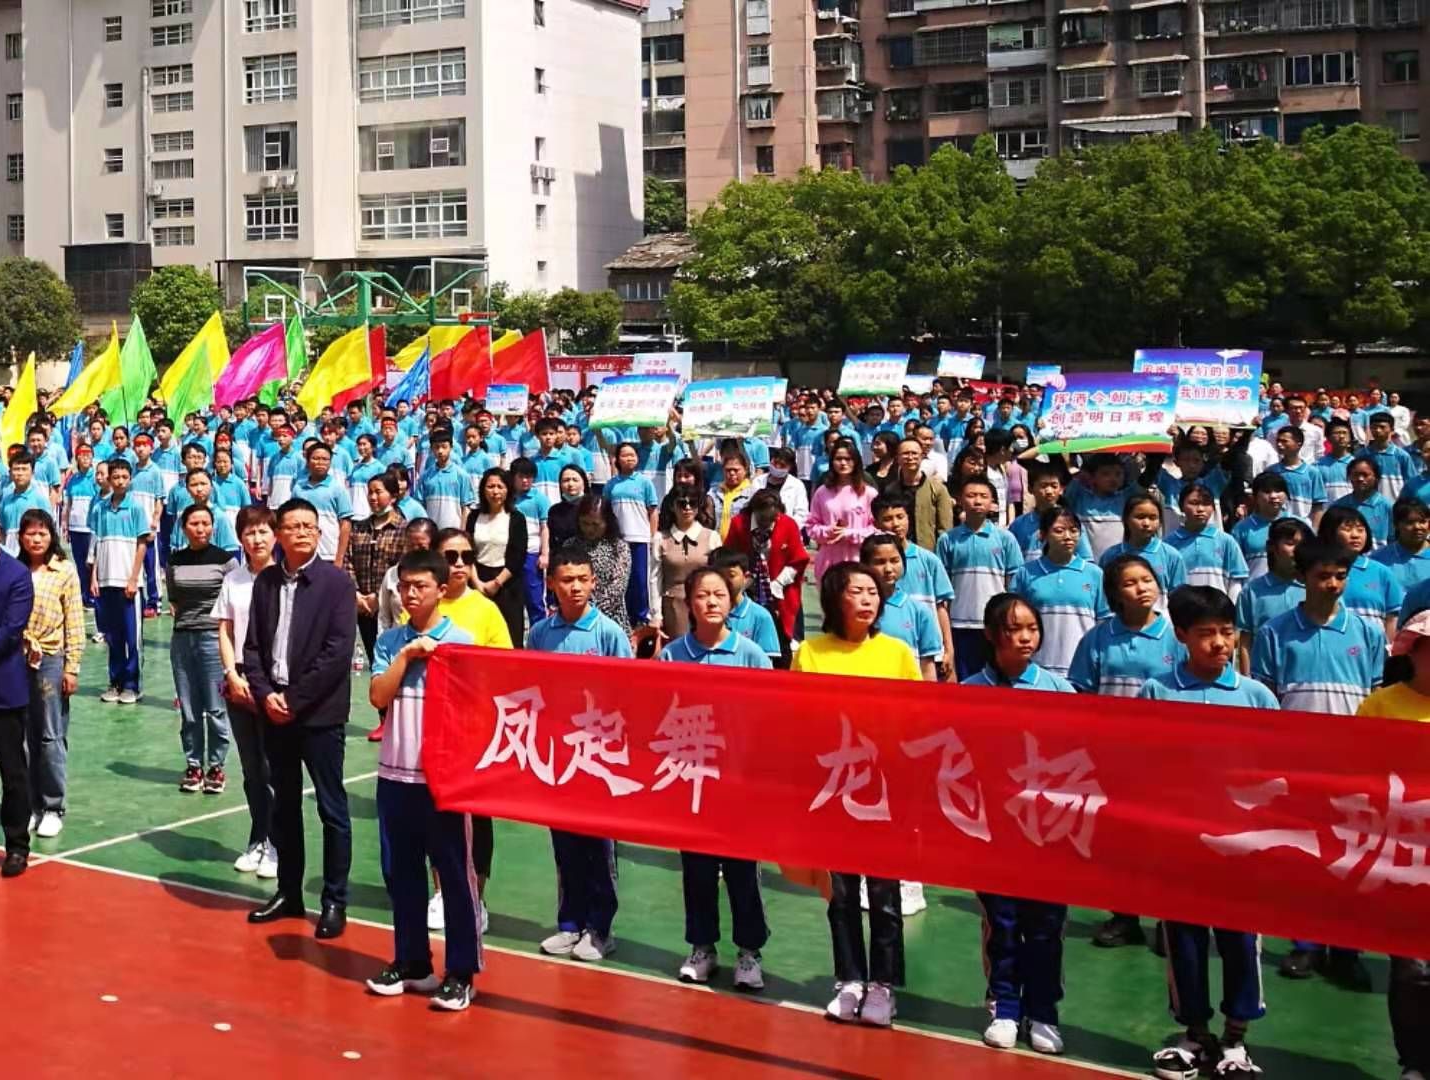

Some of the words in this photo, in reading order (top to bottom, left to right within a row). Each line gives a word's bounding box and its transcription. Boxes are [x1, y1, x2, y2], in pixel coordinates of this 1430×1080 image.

[1054, 391, 1166, 405] 挥洒今朝汗水
[1050, 410, 1165, 424] 创造明日辉煌
[475, 686, 726, 814] 凤起舞
[808, 712, 1108, 859] 龙飞扬
[1199, 771, 1430, 892] 二班
